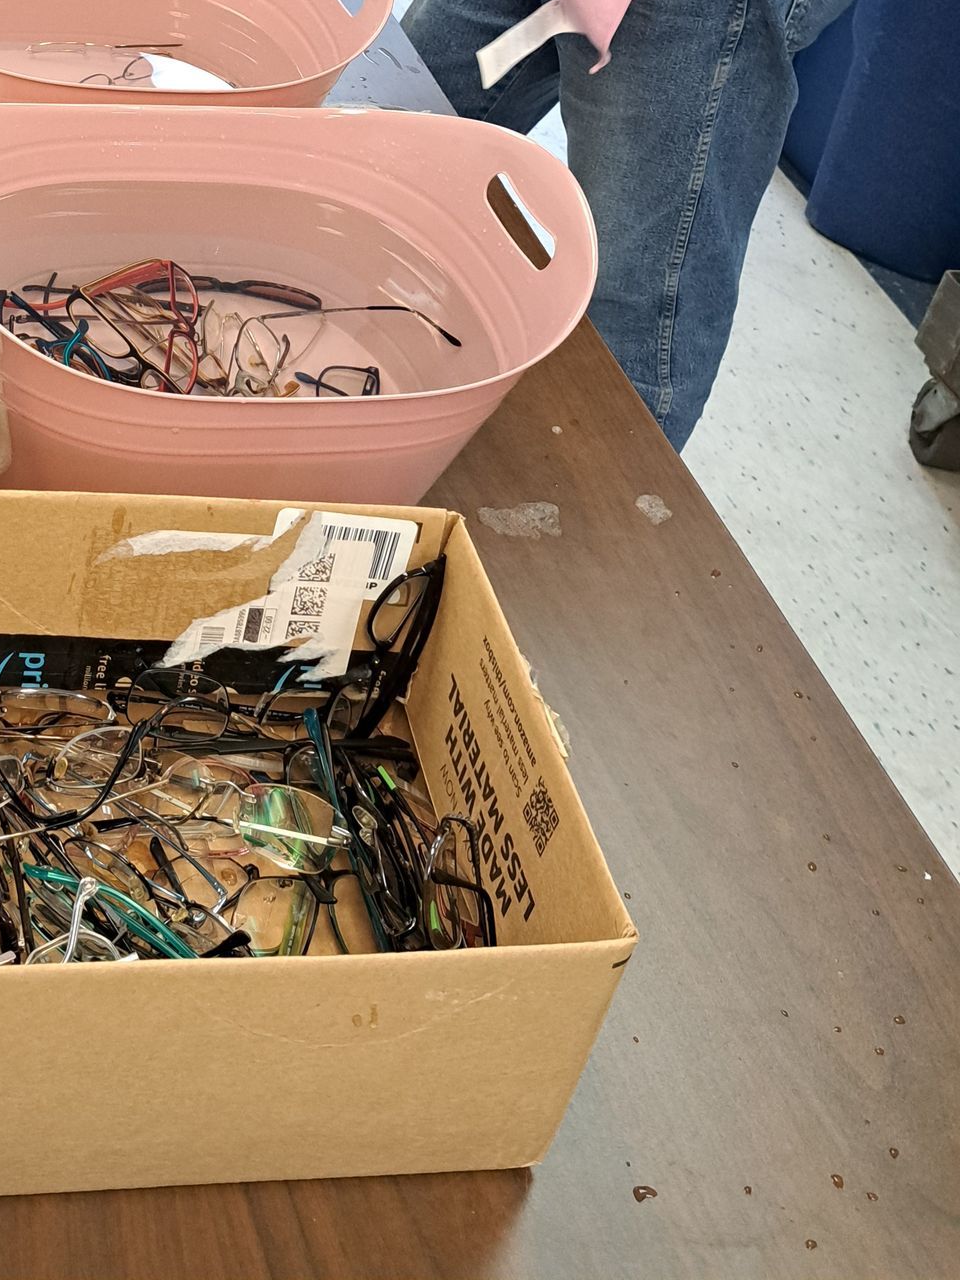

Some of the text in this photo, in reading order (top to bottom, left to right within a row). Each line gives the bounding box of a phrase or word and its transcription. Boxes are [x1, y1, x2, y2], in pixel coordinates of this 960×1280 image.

[19, 652, 49, 689] pri
[96, 654, 112, 679] free
[190, 660, 205, 686] ideo
[482, 635, 537, 767] amazon.com/thisbox
[448, 672, 505, 835] MATERIAL
[479, 657, 529, 786] less material matters
[483, 699, 522, 798] Scan to see why
[440, 763, 458, 812] NOW
[445, 723, 476, 817] WITH
[477, 809, 512, 918] MADE
[500, 832, 535, 922] LESS
